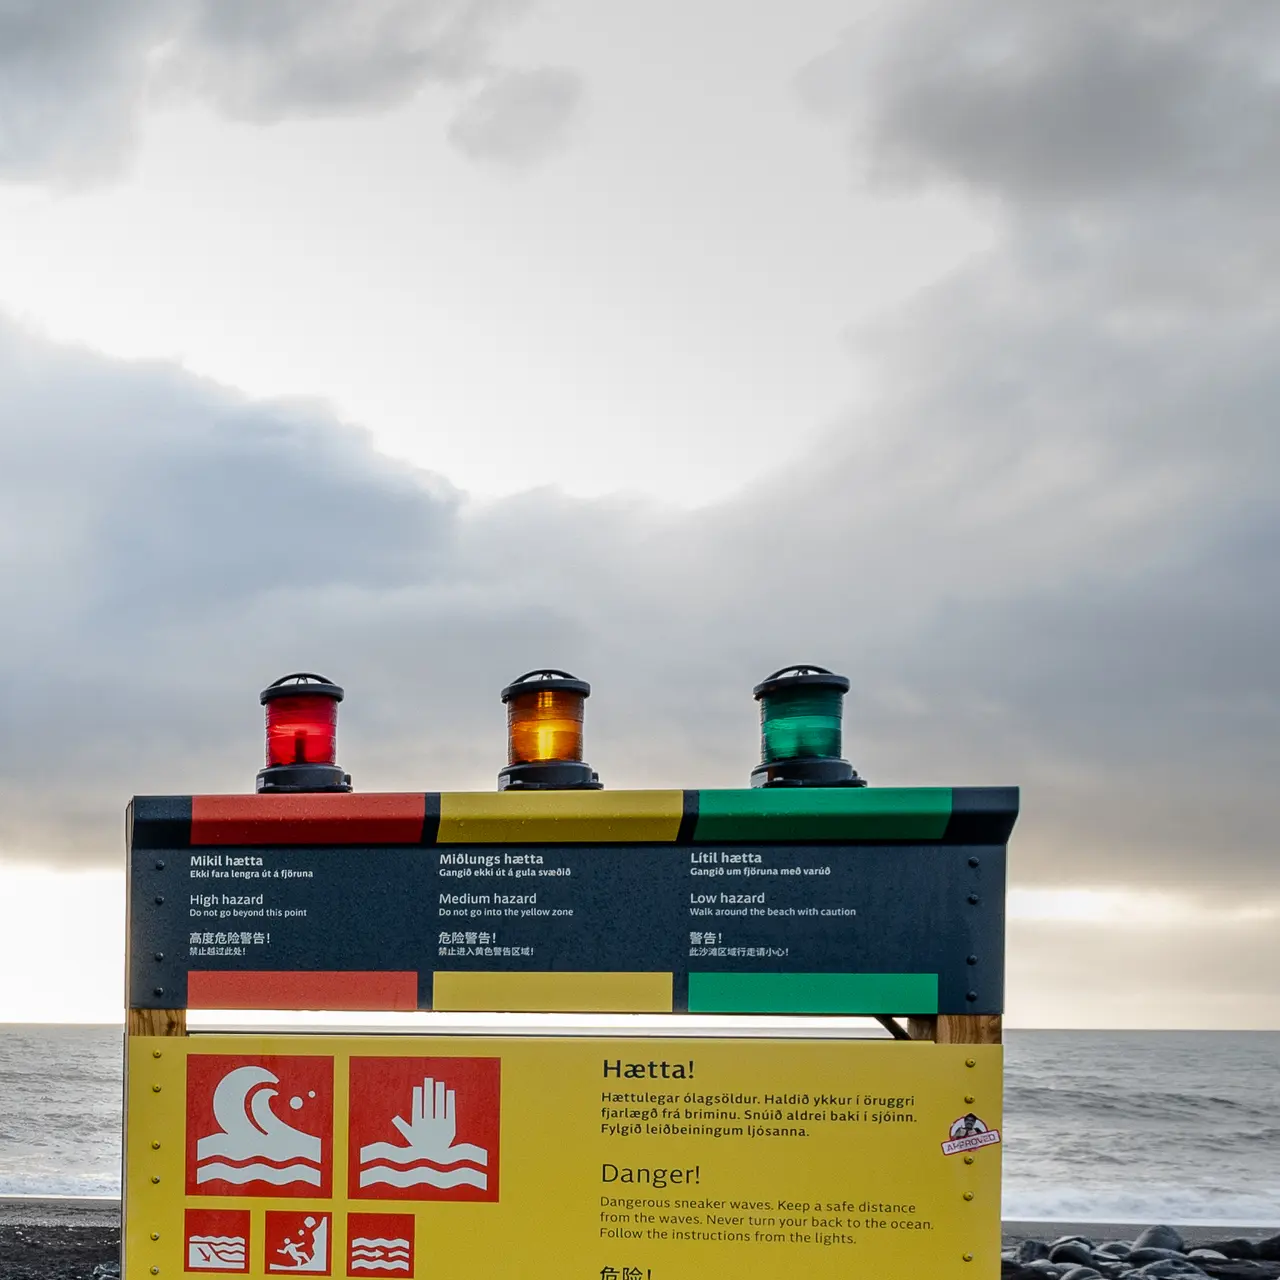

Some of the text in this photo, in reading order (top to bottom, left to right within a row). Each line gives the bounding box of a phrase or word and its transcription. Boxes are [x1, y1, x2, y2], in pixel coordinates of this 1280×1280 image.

[190, 855, 263, 866] Mikil hætta
[439, 853, 543, 867] Miðlungs hætta
[691, 851, 761, 863] Lítil hætta
[190, 869, 209, 877] Ekki
[211, 869, 229, 877] fara
[231, 869, 259, 879] lengra
[261, 869, 271, 877] út
[281, 869, 313, 879] fjöruna
[439, 867, 571, 878] Gangið ekki út á gula svæðið
[690, 867, 724, 877] Gangið
[743, 866, 778, 876] fjöruna
[780, 866, 801, 875] með
[803, 866, 830, 875] varúð
[190, 893, 263, 907] High hazard
[439, 892, 536, 904] Medium hazard
[690, 892, 764, 903] Low hazard
[189, 908, 202, 916] Do
[219, 909, 231, 918] go
[232, 908, 264, 918] beyond
[265, 908, 282, 916] this
[284, 908, 306, 918] point
[438, 907, 451, 916] Do
[453, 908, 468, 916] not
[470, 909, 482, 917] go
[484, 907, 502, 916] into
[504, 907, 519, 916] the
[520, 907, 550, 917] yellow
[689, 907, 856, 915] Walk around the beach with caution
[603, 1059, 694, 1079] Hætta!
[601, 1092, 914, 1108] Hættulegar ólagsöldur. Haldið ykkur í öruggri
[601, 1107, 916, 1124] fjarlægð frá briminu. Snúið aldrei baki í sjóinn.
[601, 1123, 809, 1138] Fylgið leiðbeiningum ljósanna.
[947, 1134, 996, 1152] APPROVED
[602, 1163, 699, 1188] Danger!
[600, 1196, 915, 1213] Dangerous sneaker waves. Keep a safe distance
[600, 1211, 933, 1230] from the waves. Never turn your back to the ocean.
[600, 1227, 856, 1246] Follow the instructions from the lights.
